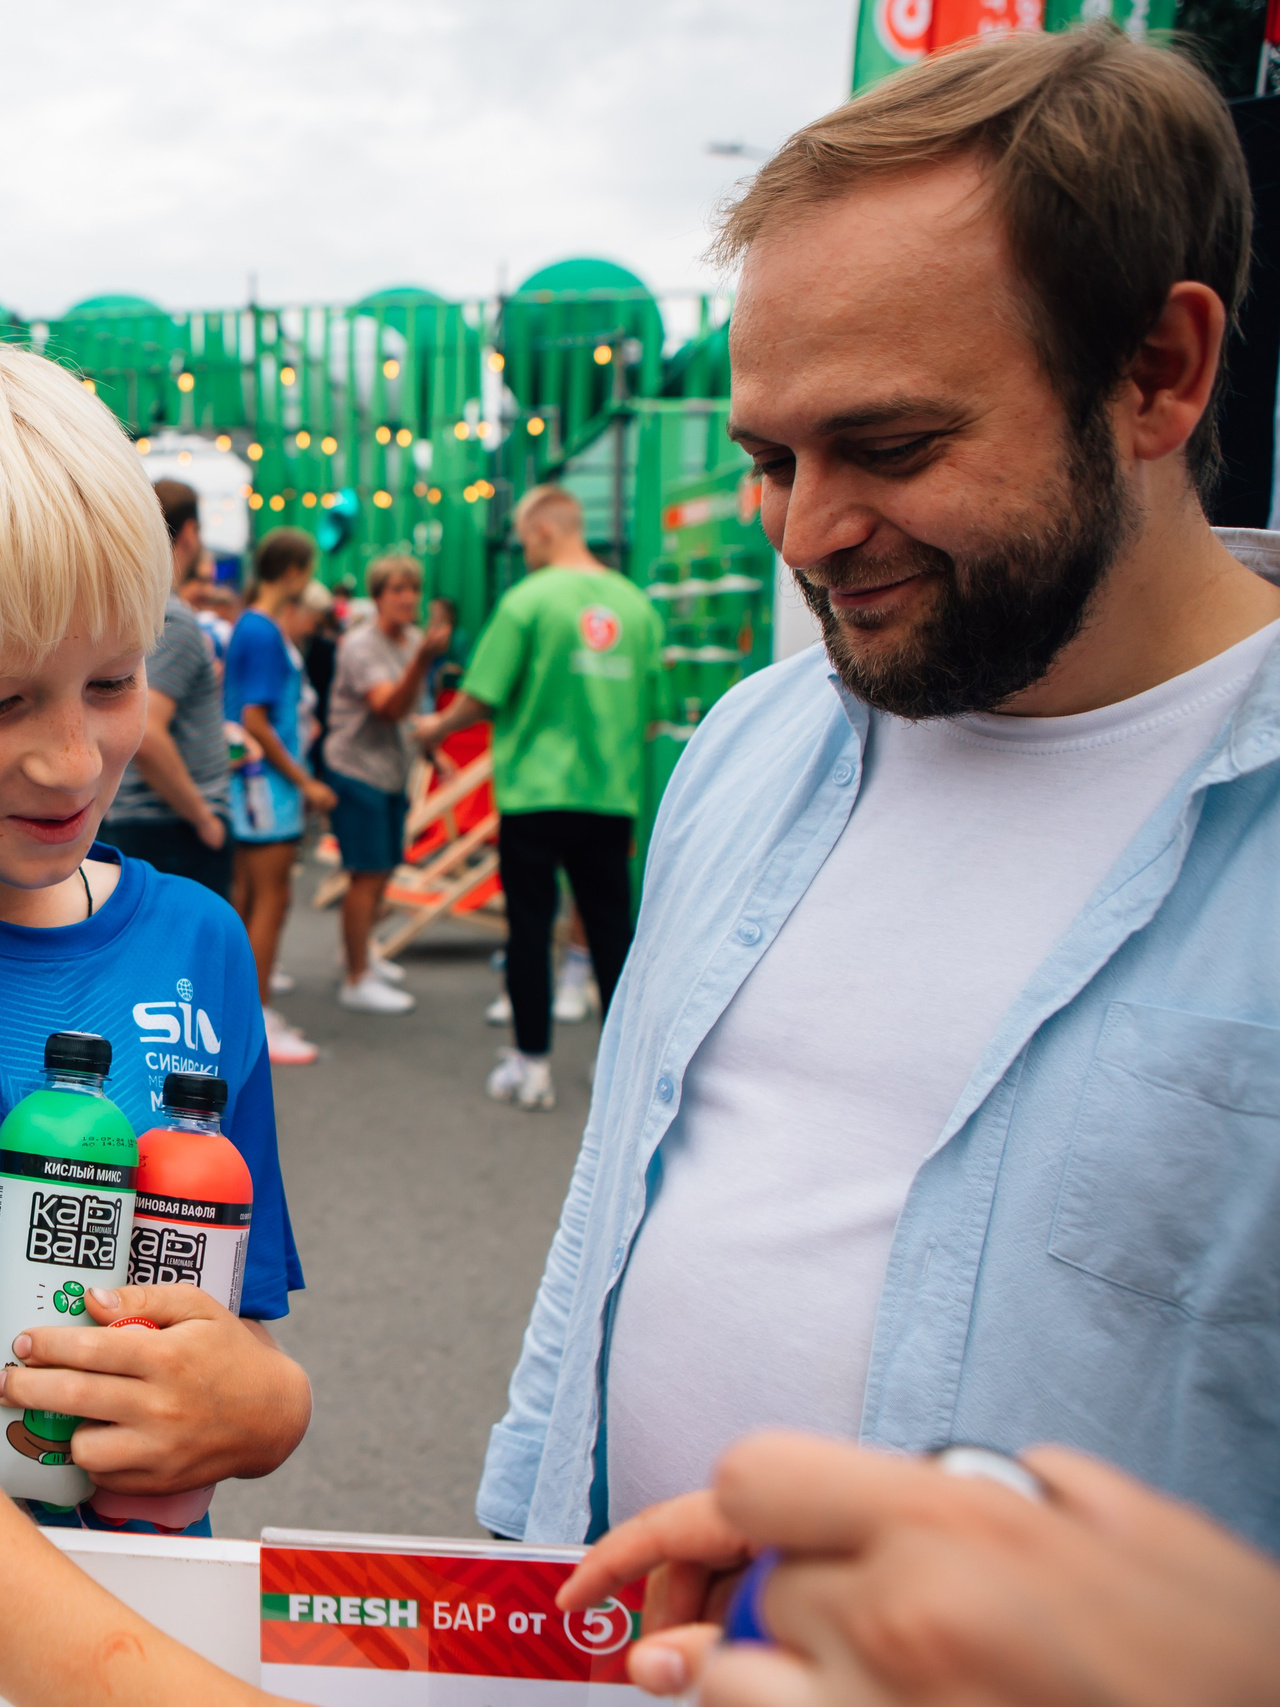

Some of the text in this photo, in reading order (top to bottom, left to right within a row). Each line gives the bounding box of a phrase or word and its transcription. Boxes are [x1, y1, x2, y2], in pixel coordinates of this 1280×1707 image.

[44, 1161, 122, 1183] КИСЛЫЙ МИКС
[181, 1203, 216, 1219] ВАФЛЯ
[89, 1225, 113, 1235] LEMONADE
[166, 1257, 194, 1268] LEMONADE
[288, 1594, 418, 1628] FRESH
[433, 1600, 496, 1632] БАР
[580, 1606, 615, 1644] 5
